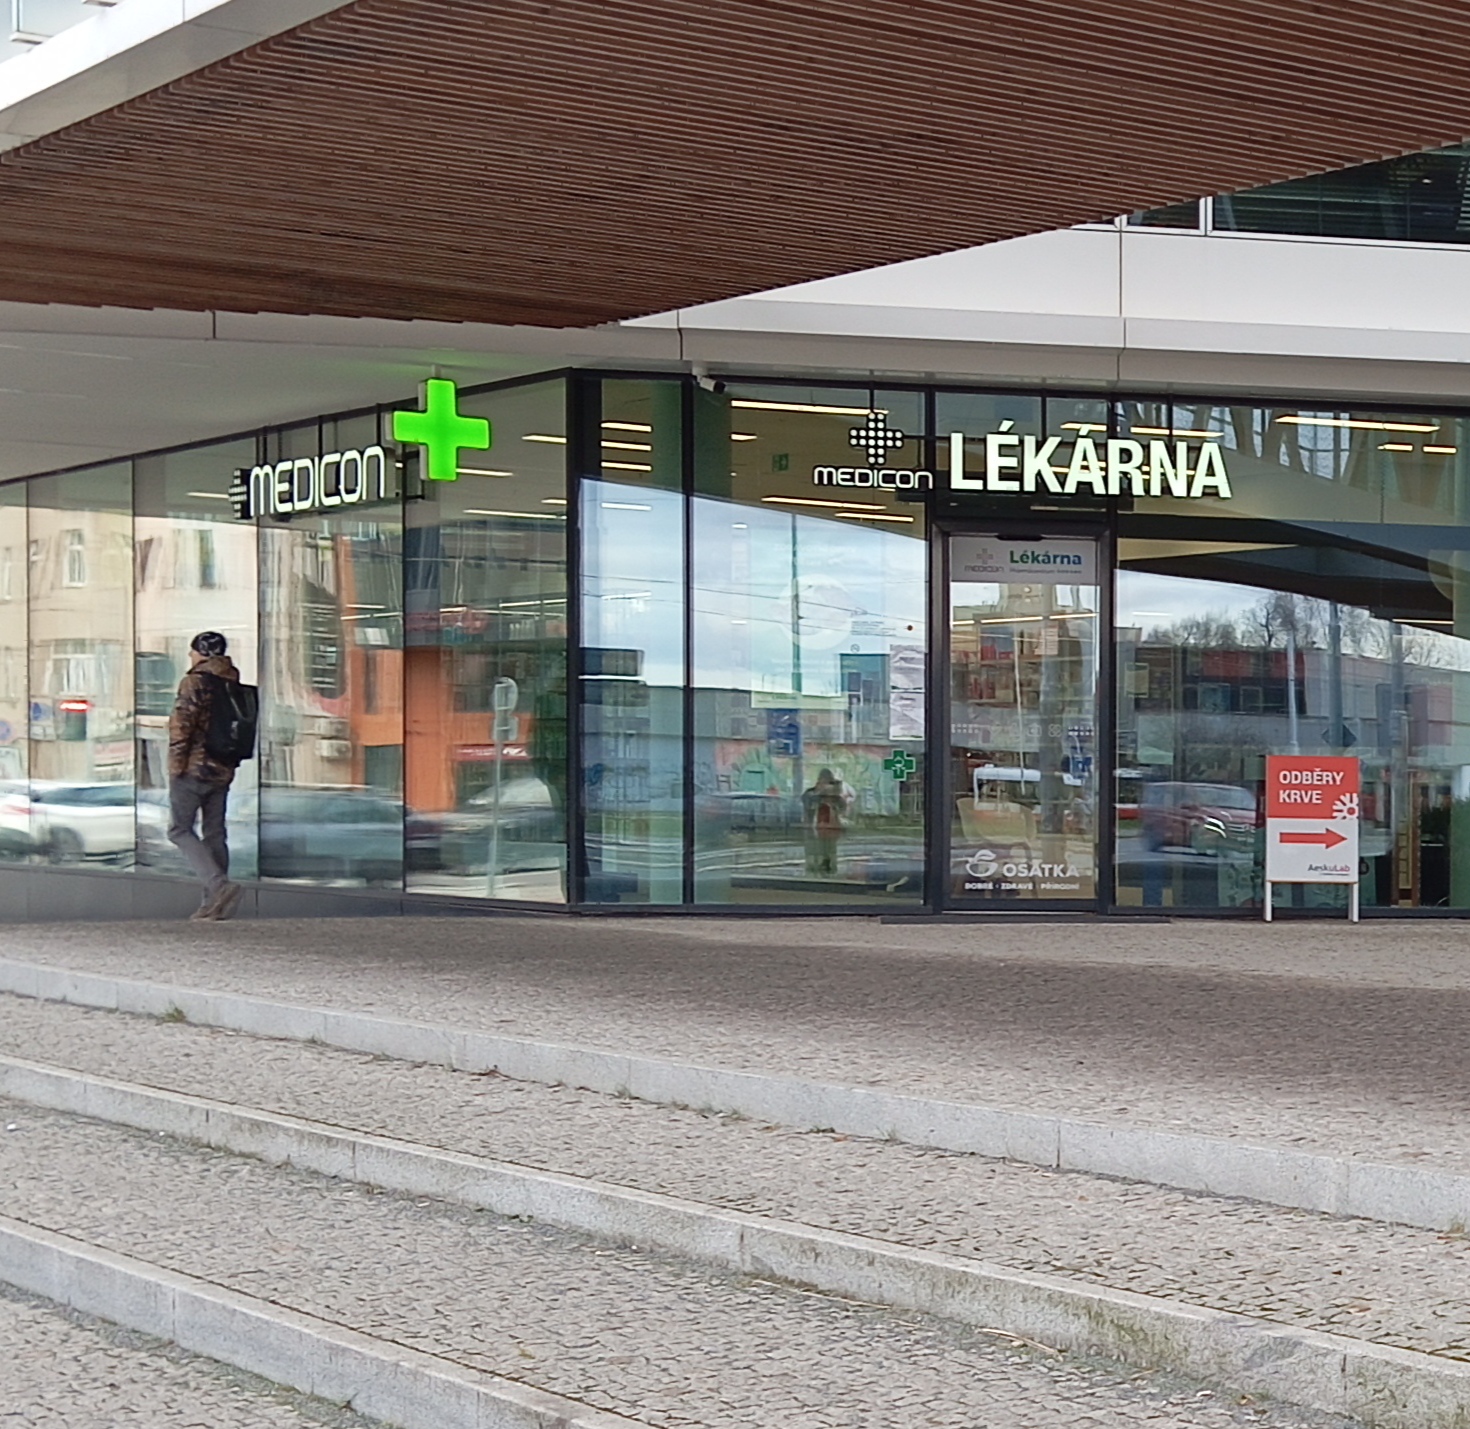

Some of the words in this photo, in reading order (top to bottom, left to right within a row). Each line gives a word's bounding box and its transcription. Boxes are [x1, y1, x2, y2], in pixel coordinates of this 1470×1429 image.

[949, 420, 1232, 498] LÉKÁRNA
[250, 445, 385, 517] MEDICON
[813, 467, 934, 489] MEDICON
[1009, 550, 1082, 566] Lékárna
[1279, 768, 1344, 785] ODBĚRY
[1279, 790, 1322, 804] KRVE
